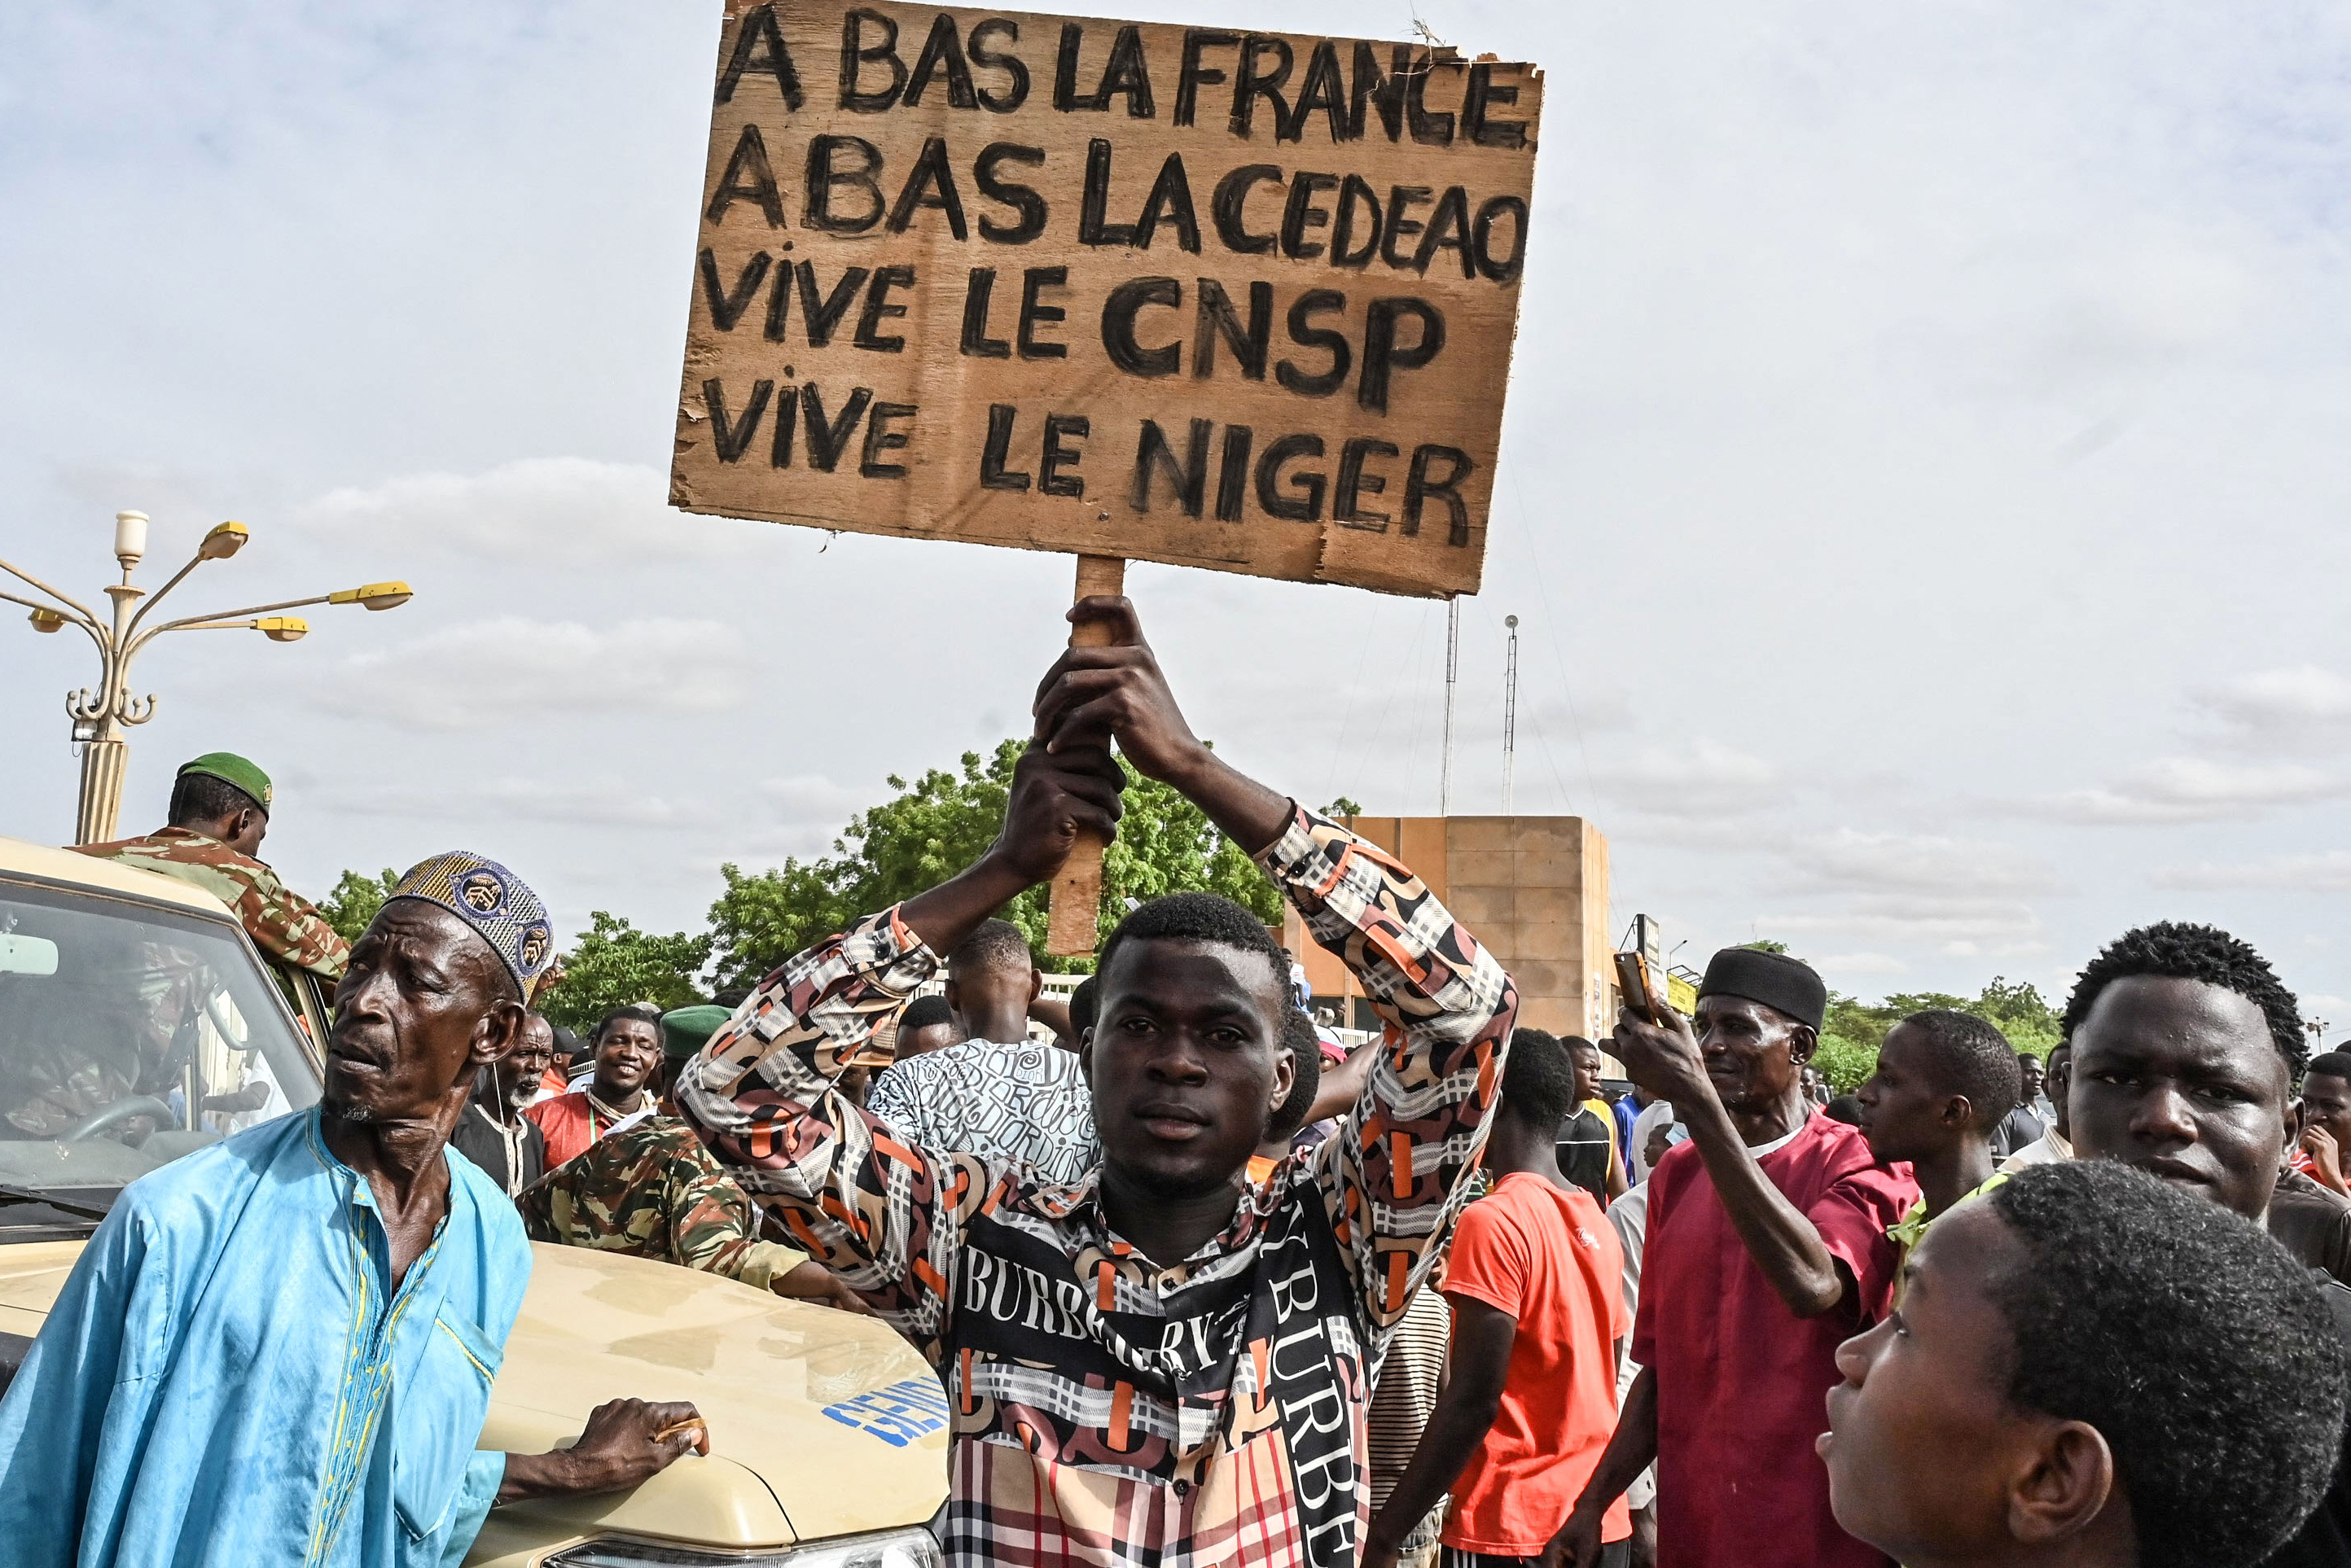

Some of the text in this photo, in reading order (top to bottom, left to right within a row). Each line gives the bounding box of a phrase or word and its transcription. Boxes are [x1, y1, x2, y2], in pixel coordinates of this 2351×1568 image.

[715, 2, 1537, 148] A BAS LA FRANCE
[705, 124, 1529, 288] A BAS LA CEDEAO
[960, 266, 1068, 358] LE
[1101, 276, 1446, 416] CNSP
[980, 404, 1090, 501] LE
[1129, 418, 1476, 549] NIGER
